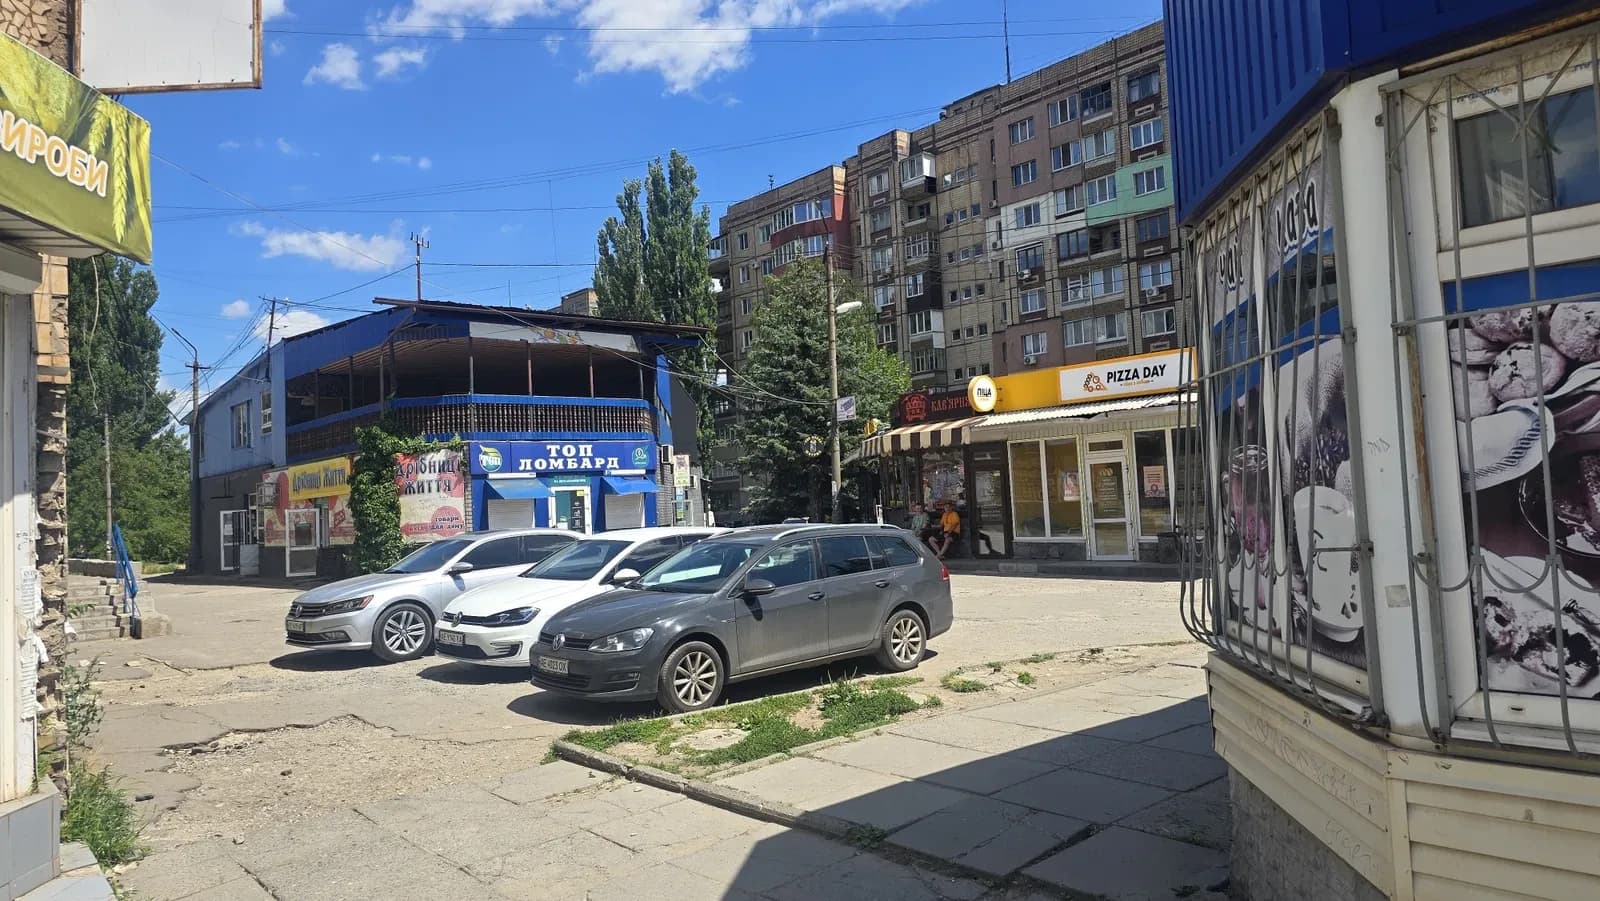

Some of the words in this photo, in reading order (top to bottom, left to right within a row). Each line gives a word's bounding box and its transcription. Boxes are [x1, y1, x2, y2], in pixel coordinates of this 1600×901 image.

[0, 109, 109, 198] ИРОБИ
[1106, 368, 1140, 384] PIZZA
[1143, 363, 1167, 379] DAY
[976, 387, 992, 397] ПІЦА
[546, 444, 593, 457] ТОП
[518, 457, 620, 471] ЛОМБАРД
